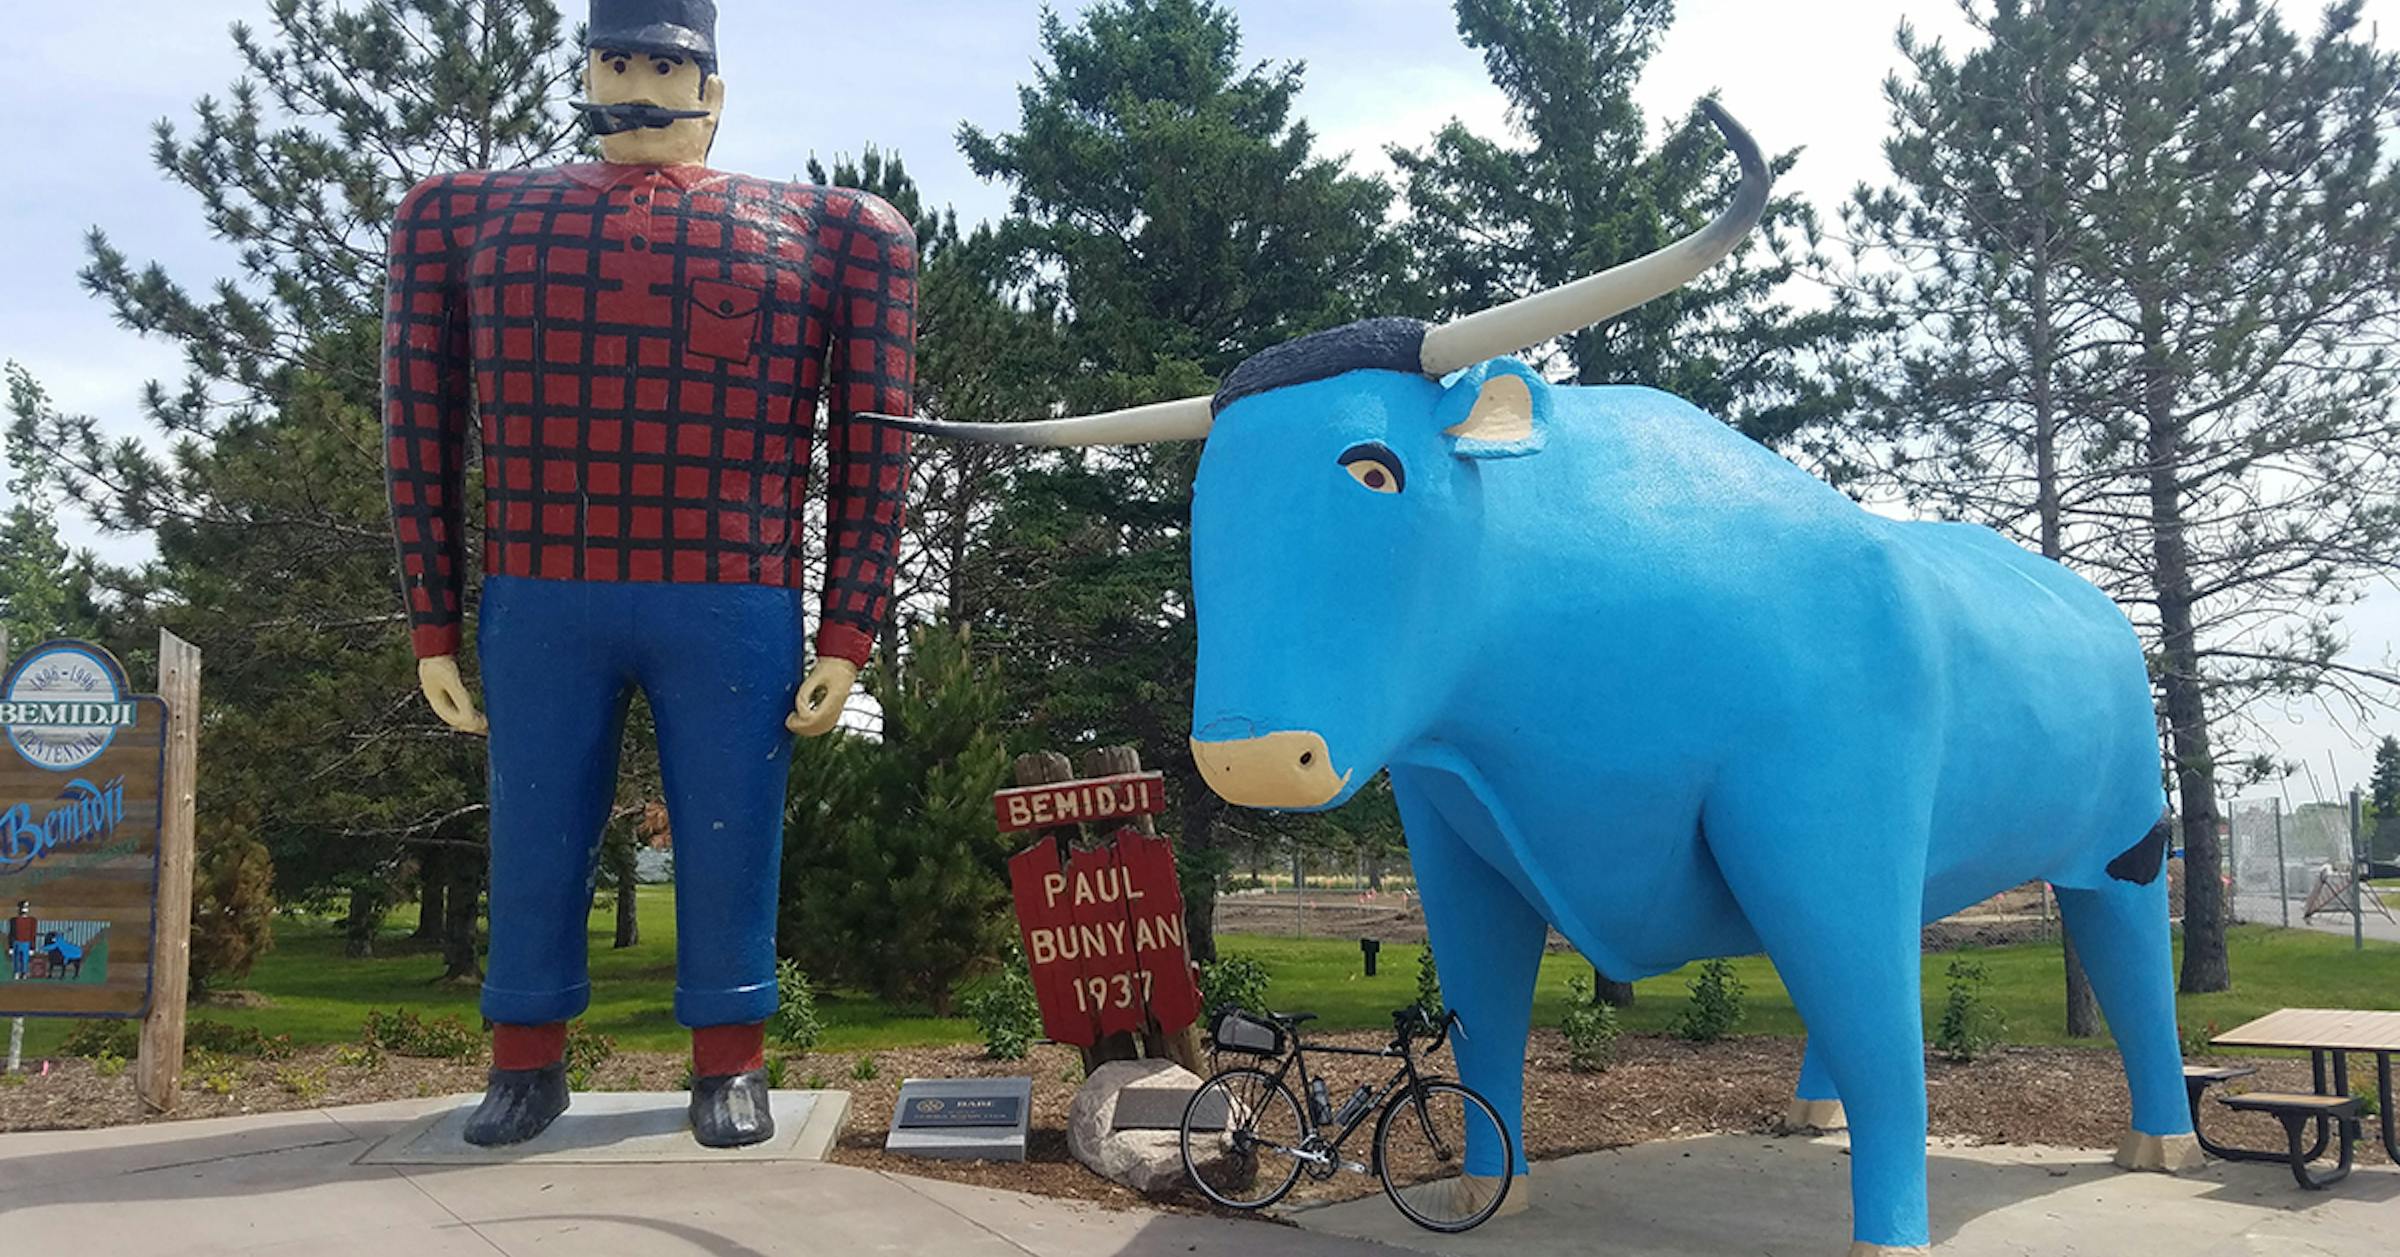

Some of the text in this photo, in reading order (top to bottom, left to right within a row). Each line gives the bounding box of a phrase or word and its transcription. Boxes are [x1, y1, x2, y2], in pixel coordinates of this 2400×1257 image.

[0, 703, 131, 724] BEMIDJI
[0, 775, 127, 864] Bemidji
[1008, 782, 1150, 827] BEMIDJI
[1044, 865, 1144, 908] PAUL
[1031, 912, 1182, 964] BUNYAN
[1073, 970, 1152, 1012] 1937
